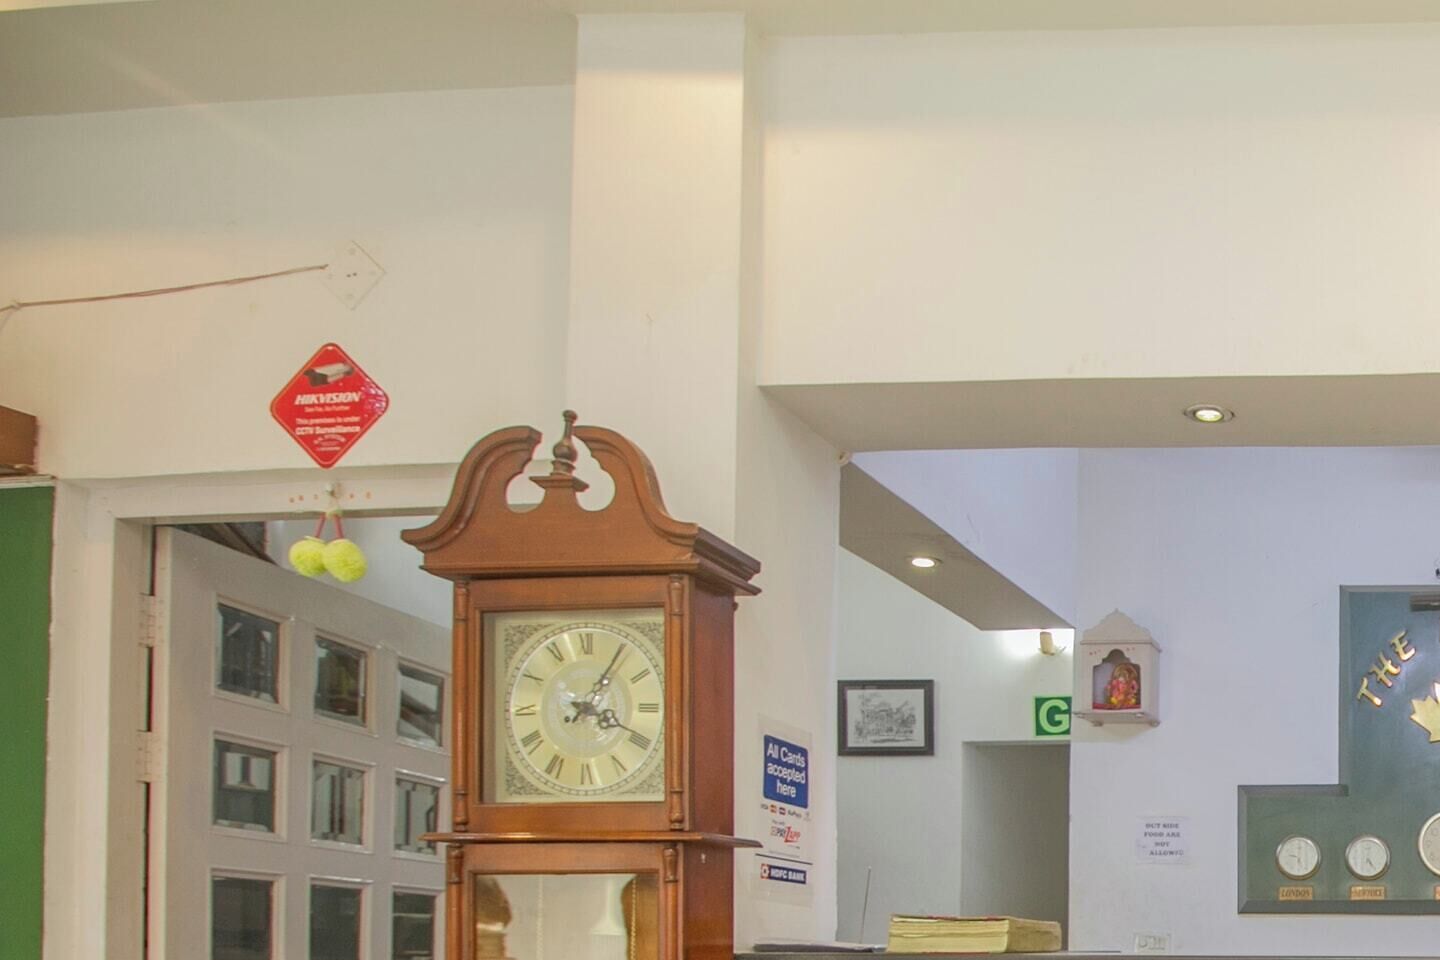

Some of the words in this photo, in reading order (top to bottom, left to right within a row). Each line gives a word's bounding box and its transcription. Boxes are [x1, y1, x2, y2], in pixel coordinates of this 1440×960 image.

[294, 391, 361, 405] HIKVISION
[1356, 629, 1416, 709] THE
[767, 743, 779, 759] All
[780, 746, 806, 768] Cards
[767, 762, 806, 785] accepted
[776, 779, 797, 798] here
[788, 870, 805, 883] BANK
[1280, 887, 1311, 898] LONDON
